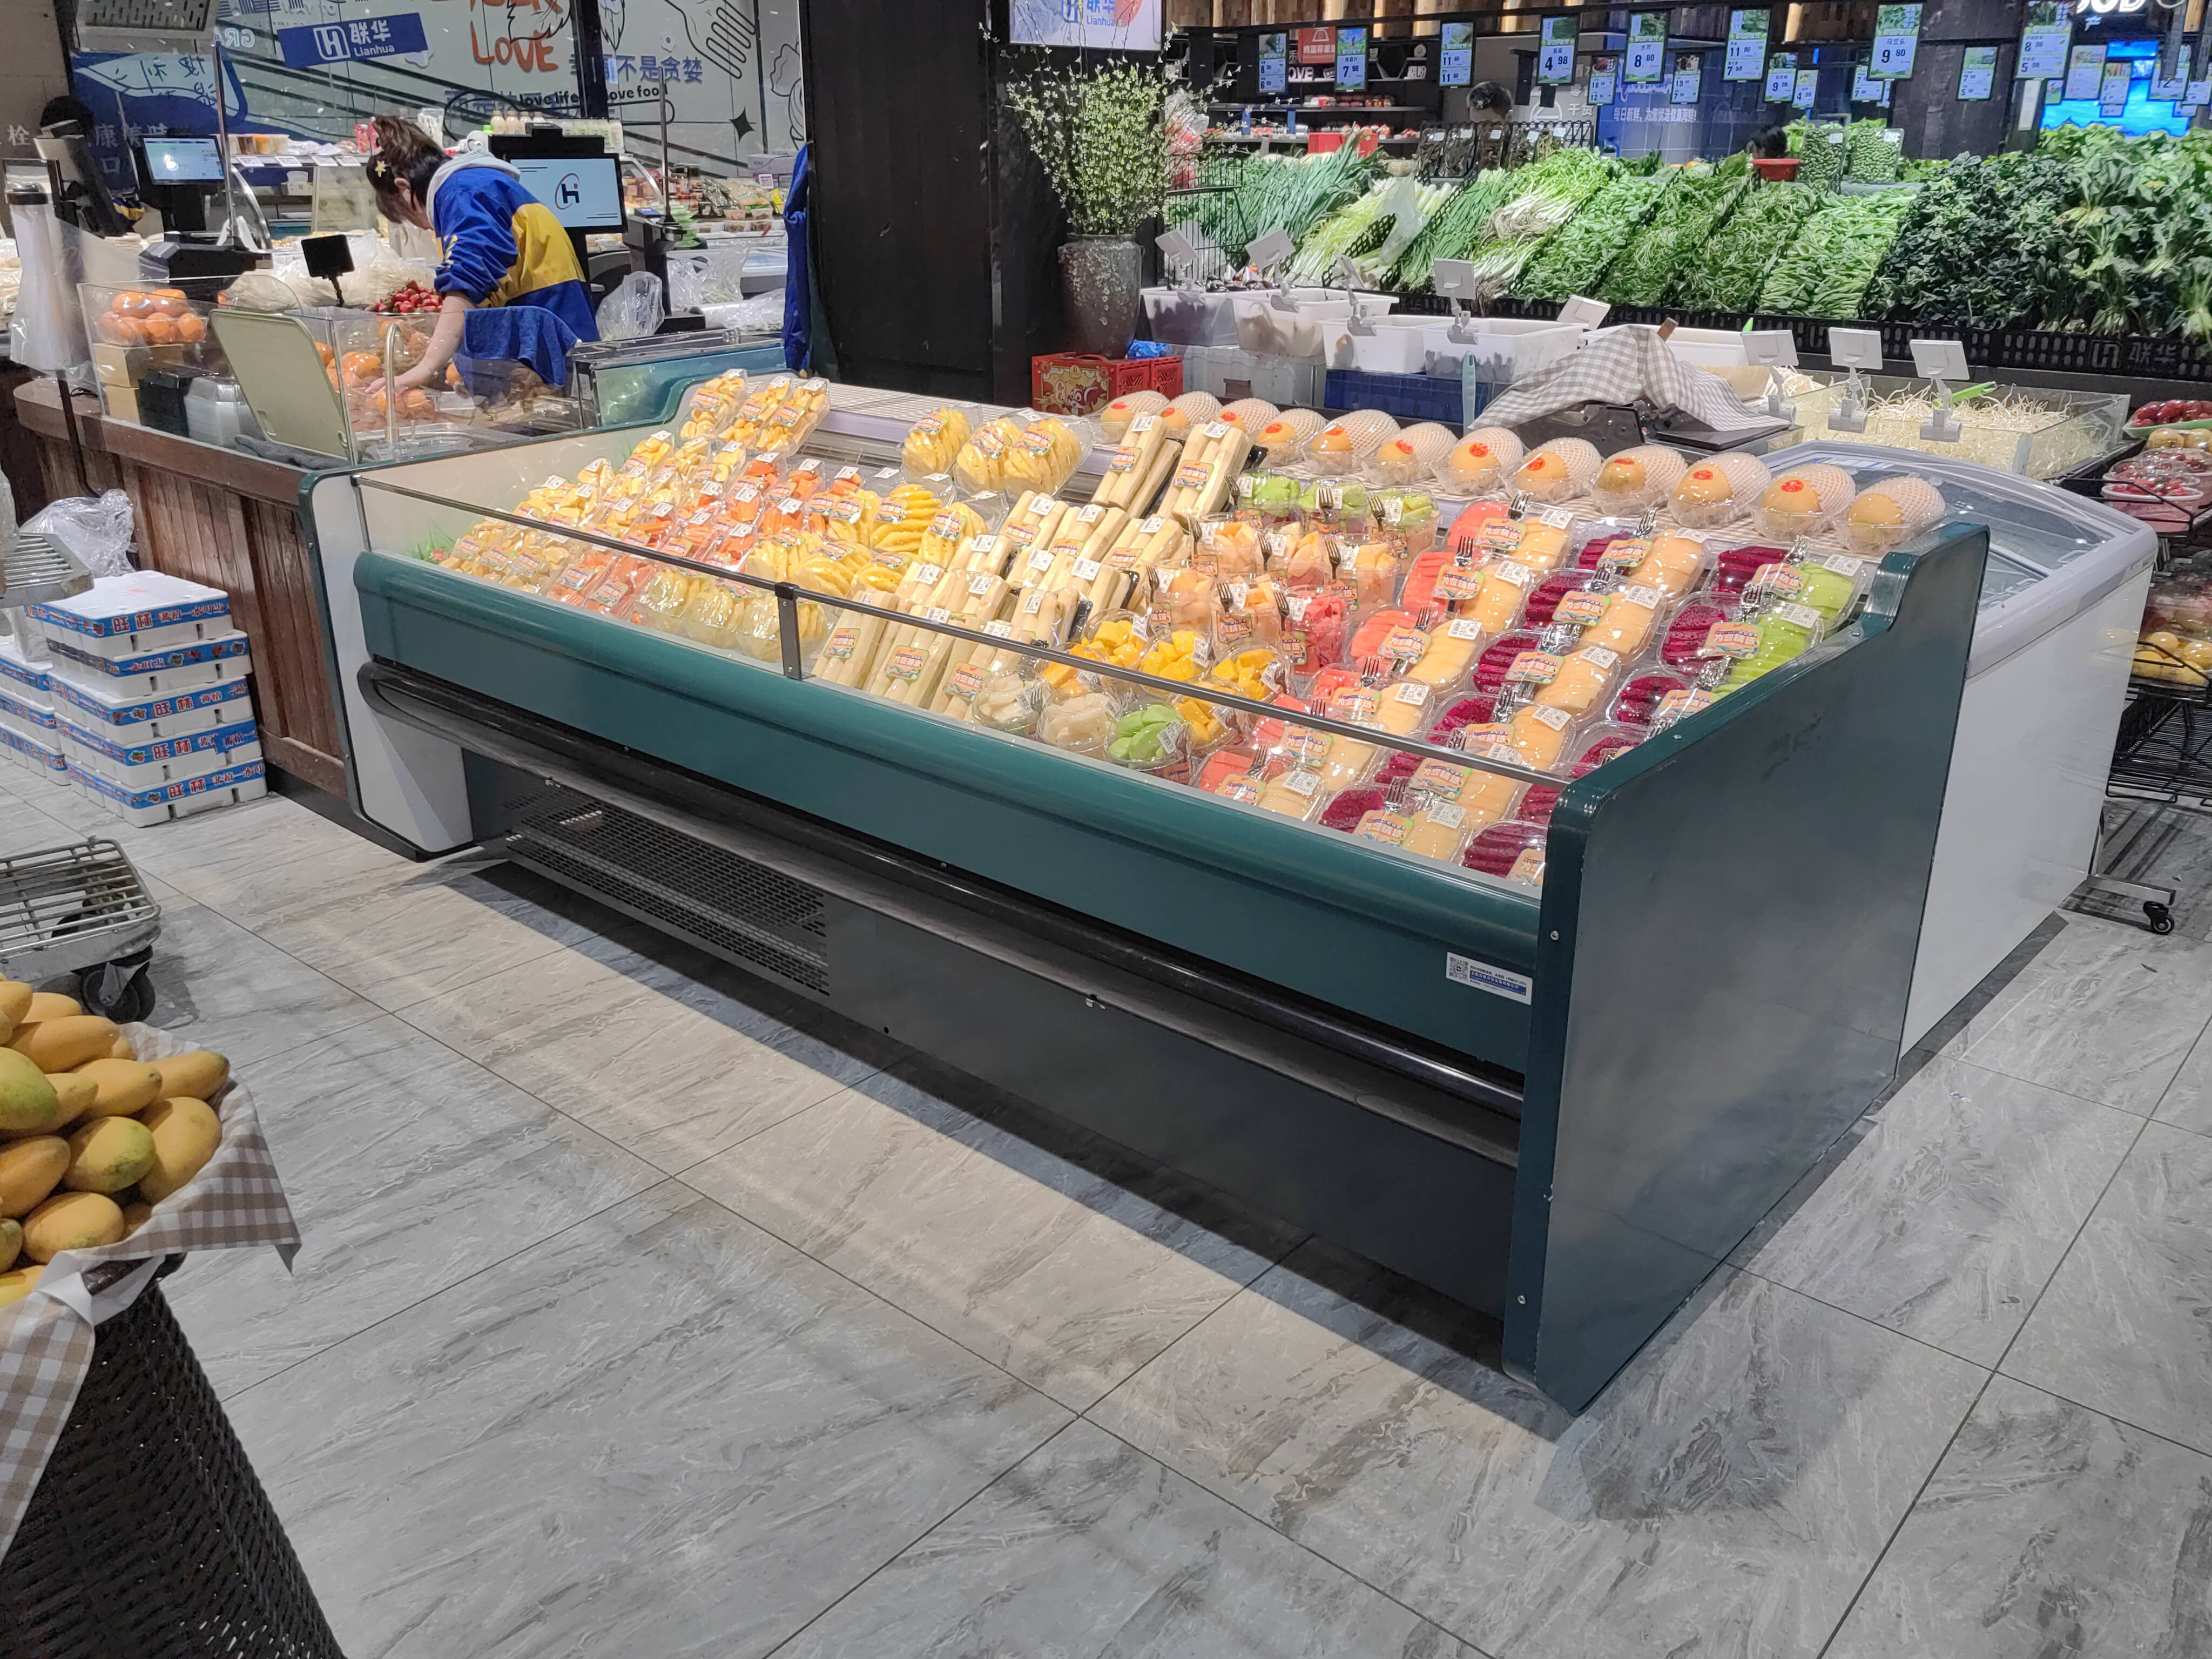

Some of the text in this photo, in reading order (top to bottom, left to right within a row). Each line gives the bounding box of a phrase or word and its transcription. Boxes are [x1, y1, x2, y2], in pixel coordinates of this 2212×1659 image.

[1087, 15, 1115, 26] Lianhua
[349, 20, 392, 45] 联华
[354, 44, 395, 58] Lianhua
[470, 21, 559, 72] LOVE
[1730, 47, 1740, 57] 11
[1444, 57, 1451, 65] 11
[1634, 55, 1642, 68] 8
[1881, 49, 1905, 63] 9 80
[569, 54, 703, 84] 不是贪婪
[1545, 56, 1568, 71] 4 98
[2021, 63, 2028, 72] 5
[1288, 66, 1314, 80] OVE
[1343, 66, 1349, 77] 7
[1727, 66, 1733, 76] 7
[1442, 74, 1450, 82] 11
[1772, 82, 1778, 91] 9
[608, 89, 635, 100] ove
[1797, 92, 1802, 100] 4
